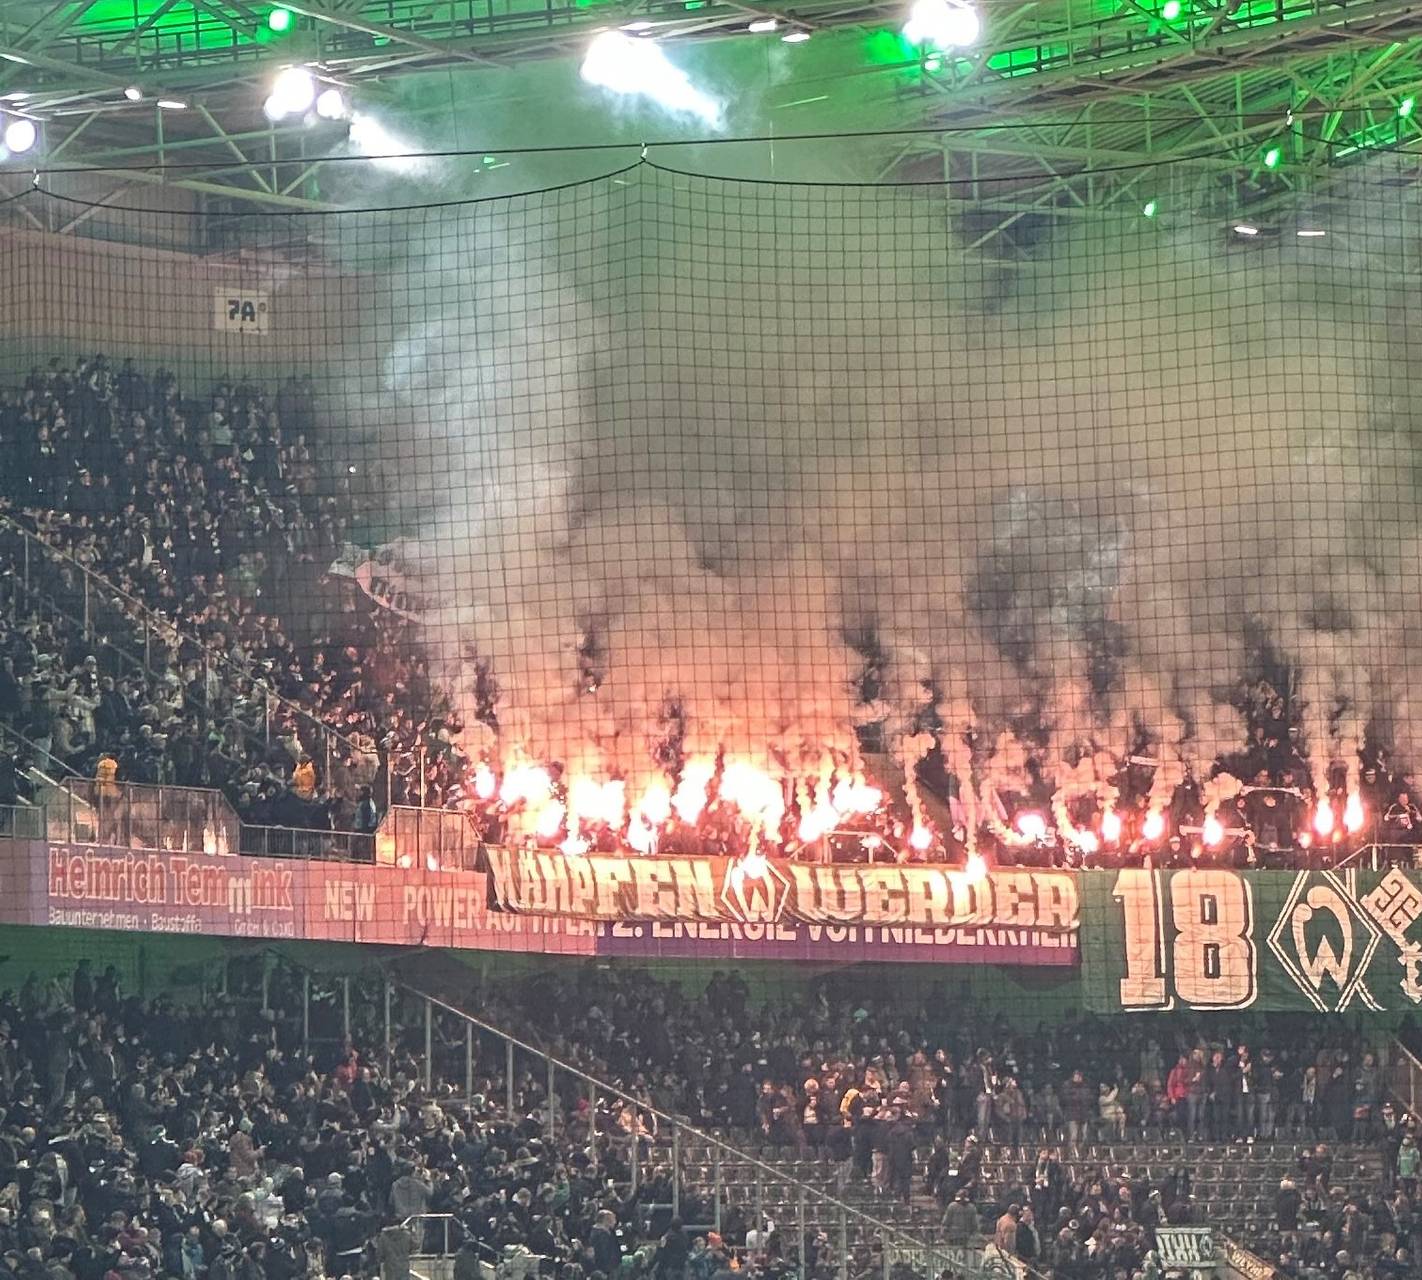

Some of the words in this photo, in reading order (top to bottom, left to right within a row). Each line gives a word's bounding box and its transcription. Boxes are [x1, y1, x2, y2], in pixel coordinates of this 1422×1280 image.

[48, 847, 167, 903] Heinrich
[170, 856, 294, 914] Temmink
[324, 880, 376, 921] NEW
[404, 885, 489, 930] POWER
[788, 861, 1081, 929] WERDER
[1112, 868, 1258, 1012] 18
